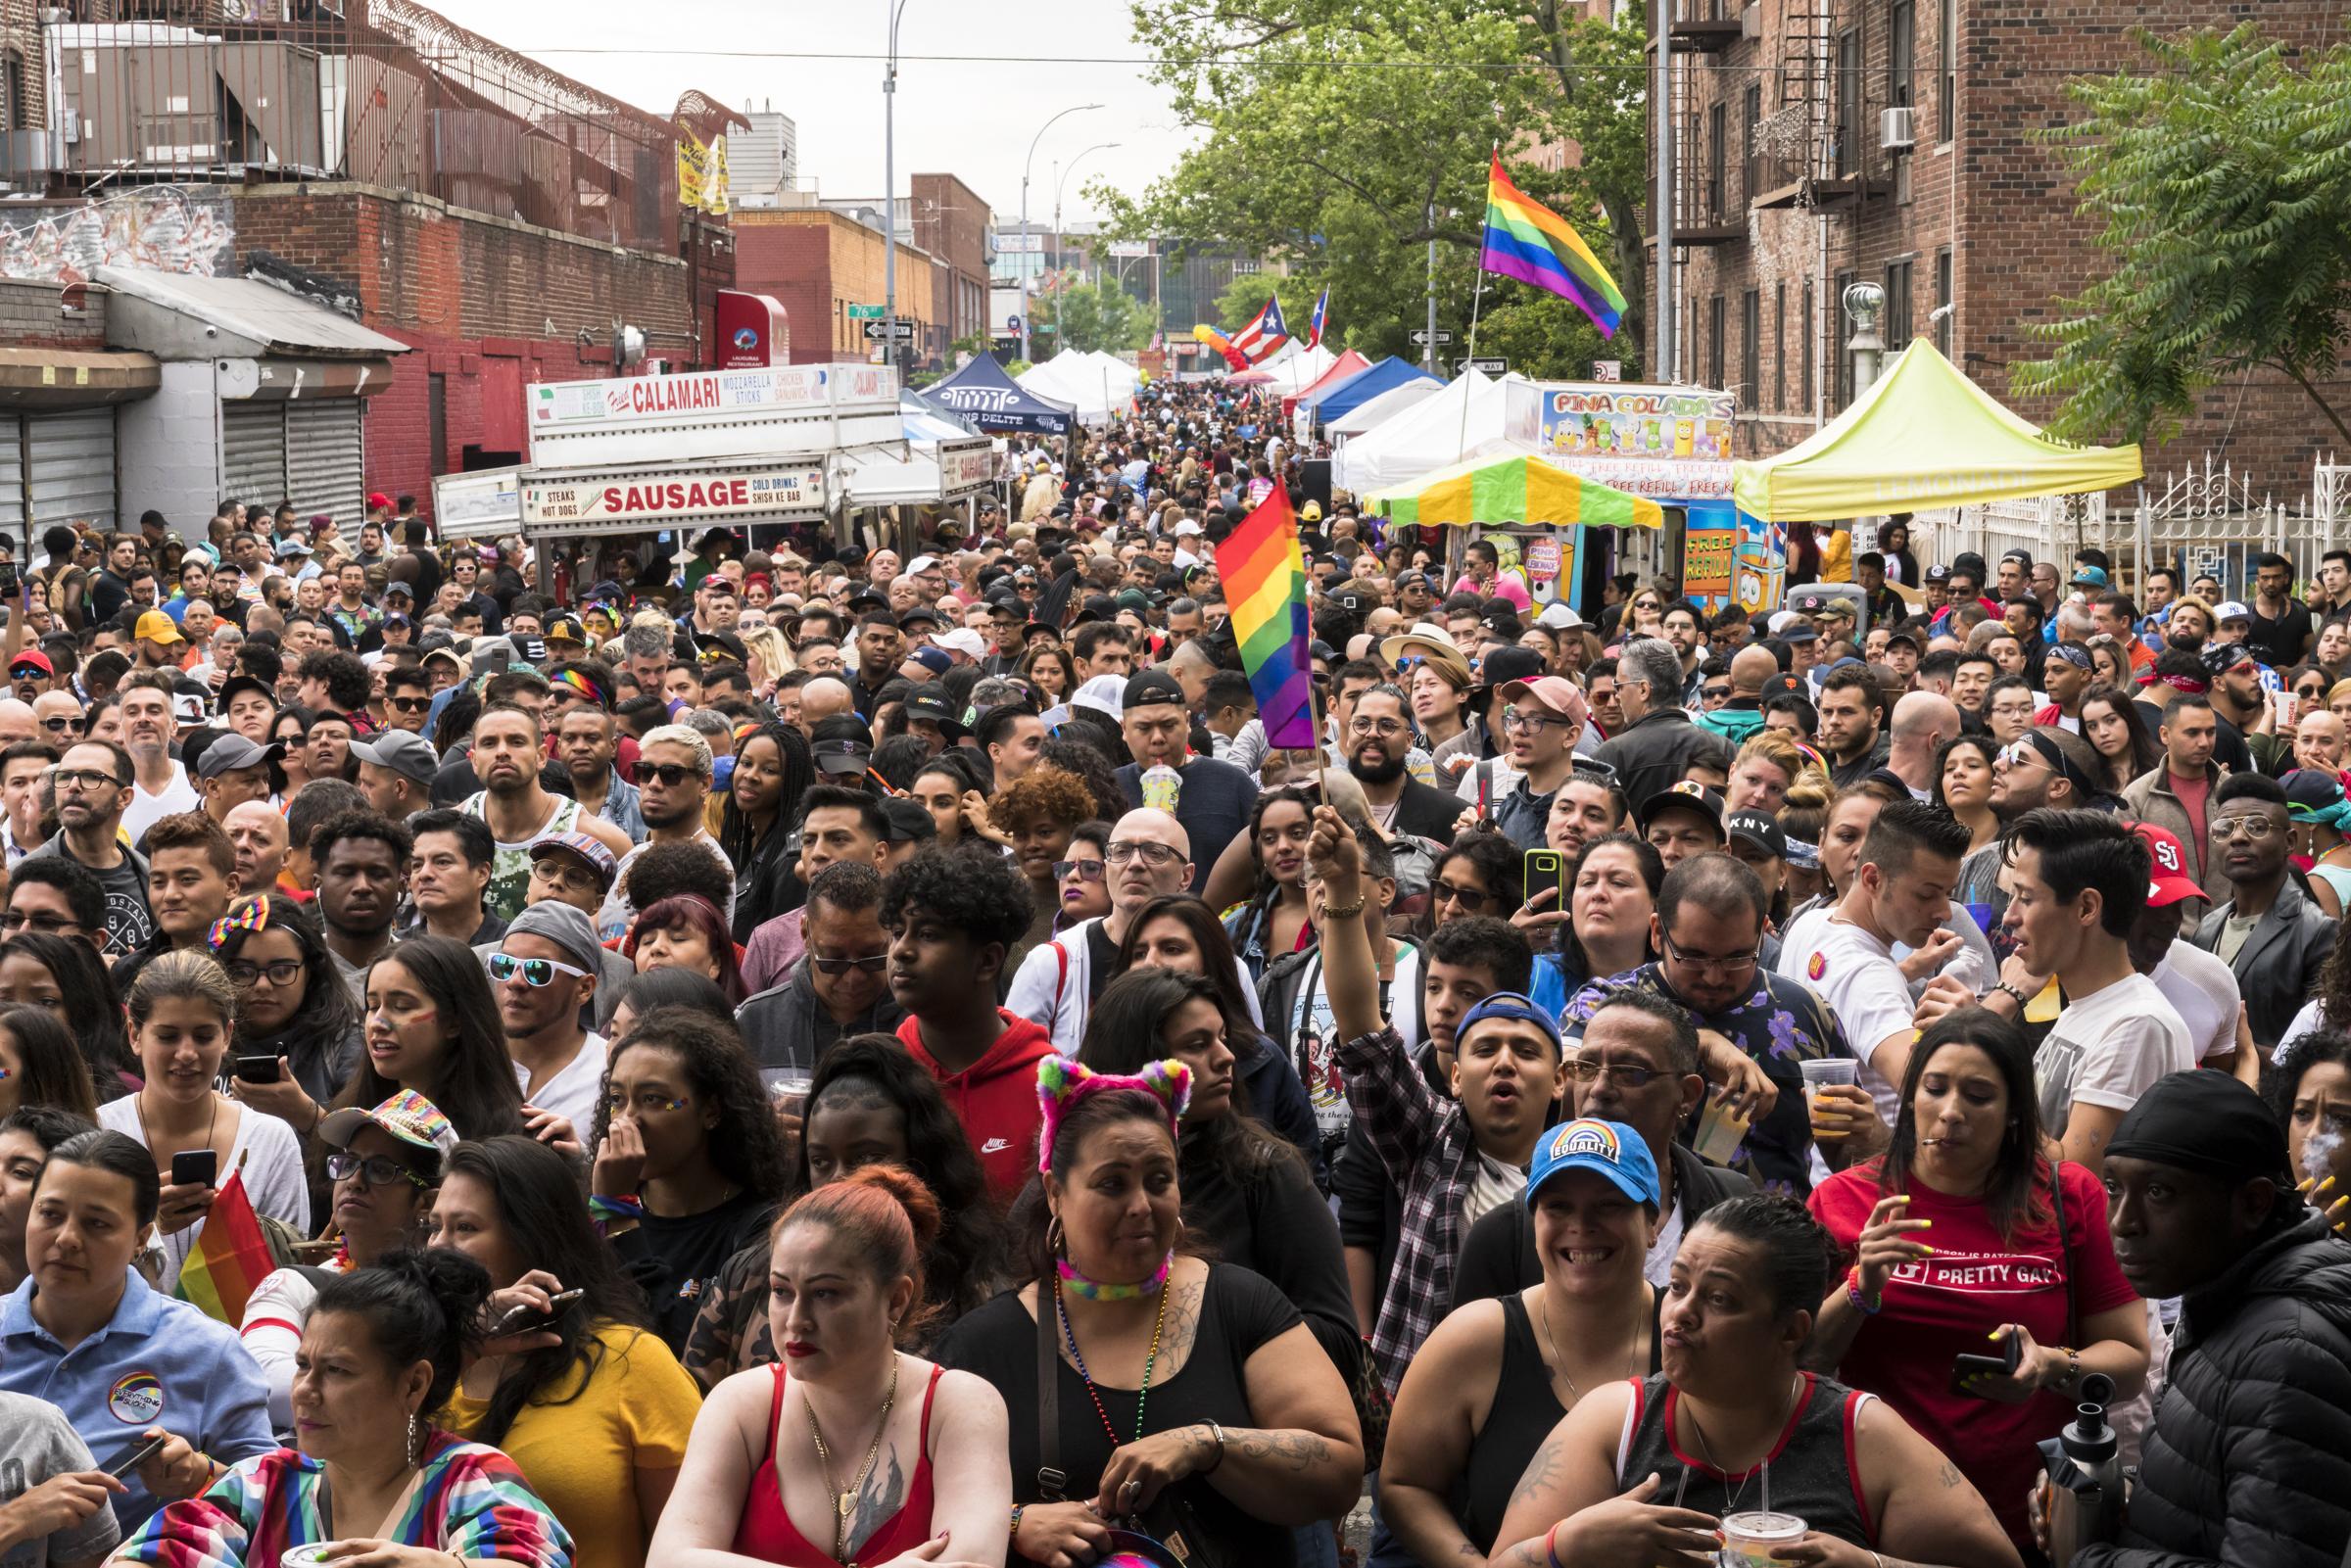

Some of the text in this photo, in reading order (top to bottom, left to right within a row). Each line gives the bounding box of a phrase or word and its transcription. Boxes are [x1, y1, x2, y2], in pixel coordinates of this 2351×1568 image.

[855, 307, 869, 317] 76
[723, 374, 771, 391] MOZZARELLA
[777, 373, 803, 387] CHICKEN
[632, 376, 720, 413] CALAMARI
[736, 391, 761, 404] STICKS
[775, 386, 808, 402] SANDWICH
[1557, 395, 1734, 419] PINA COLADA'S
[982, 412, 1024, 425] DELITE
[1592, 461, 1618, 473] FREE
[1625, 461, 1663, 473] REFILL
[1676, 461, 1707, 473] FREE
[752, 477, 798, 491] COLD DRINKS
[1607, 479, 1634, 493] FREE
[1640, 479, 1677, 494] REFILL
[1690, 479, 1720, 494] FREE
[547, 490, 576, 503] STEAKS
[603, 479, 749, 512] SAUSAGE
[752, 491, 801, 503] SHISH KE BAB
[542, 504, 578, 517] HOT DOGS
[1687, 534, 1732, 553] FREE
[1530, 546, 1556, 557] PINK
[1686, 556, 1731, 581] REFILL
[918, 696, 943, 708] EQUALITY
[2287, 700, 2296, 726] URGER
[1730, 817, 1770, 833] KNY
[109, 915, 118, 929] 9
[126, 928, 136, 944] 8
[986, 1137, 1008, 1148] NIKE
[1554, 1141, 1615, 1158] EQUALITY
[1937, 1264, 2010, 1285] PRETTY
[2016, 1265, 2052, 1284] GAY
[114, 1388, 160, 1407] EVERYTHING
[122, 1398, 147, 1409] SUCKS
